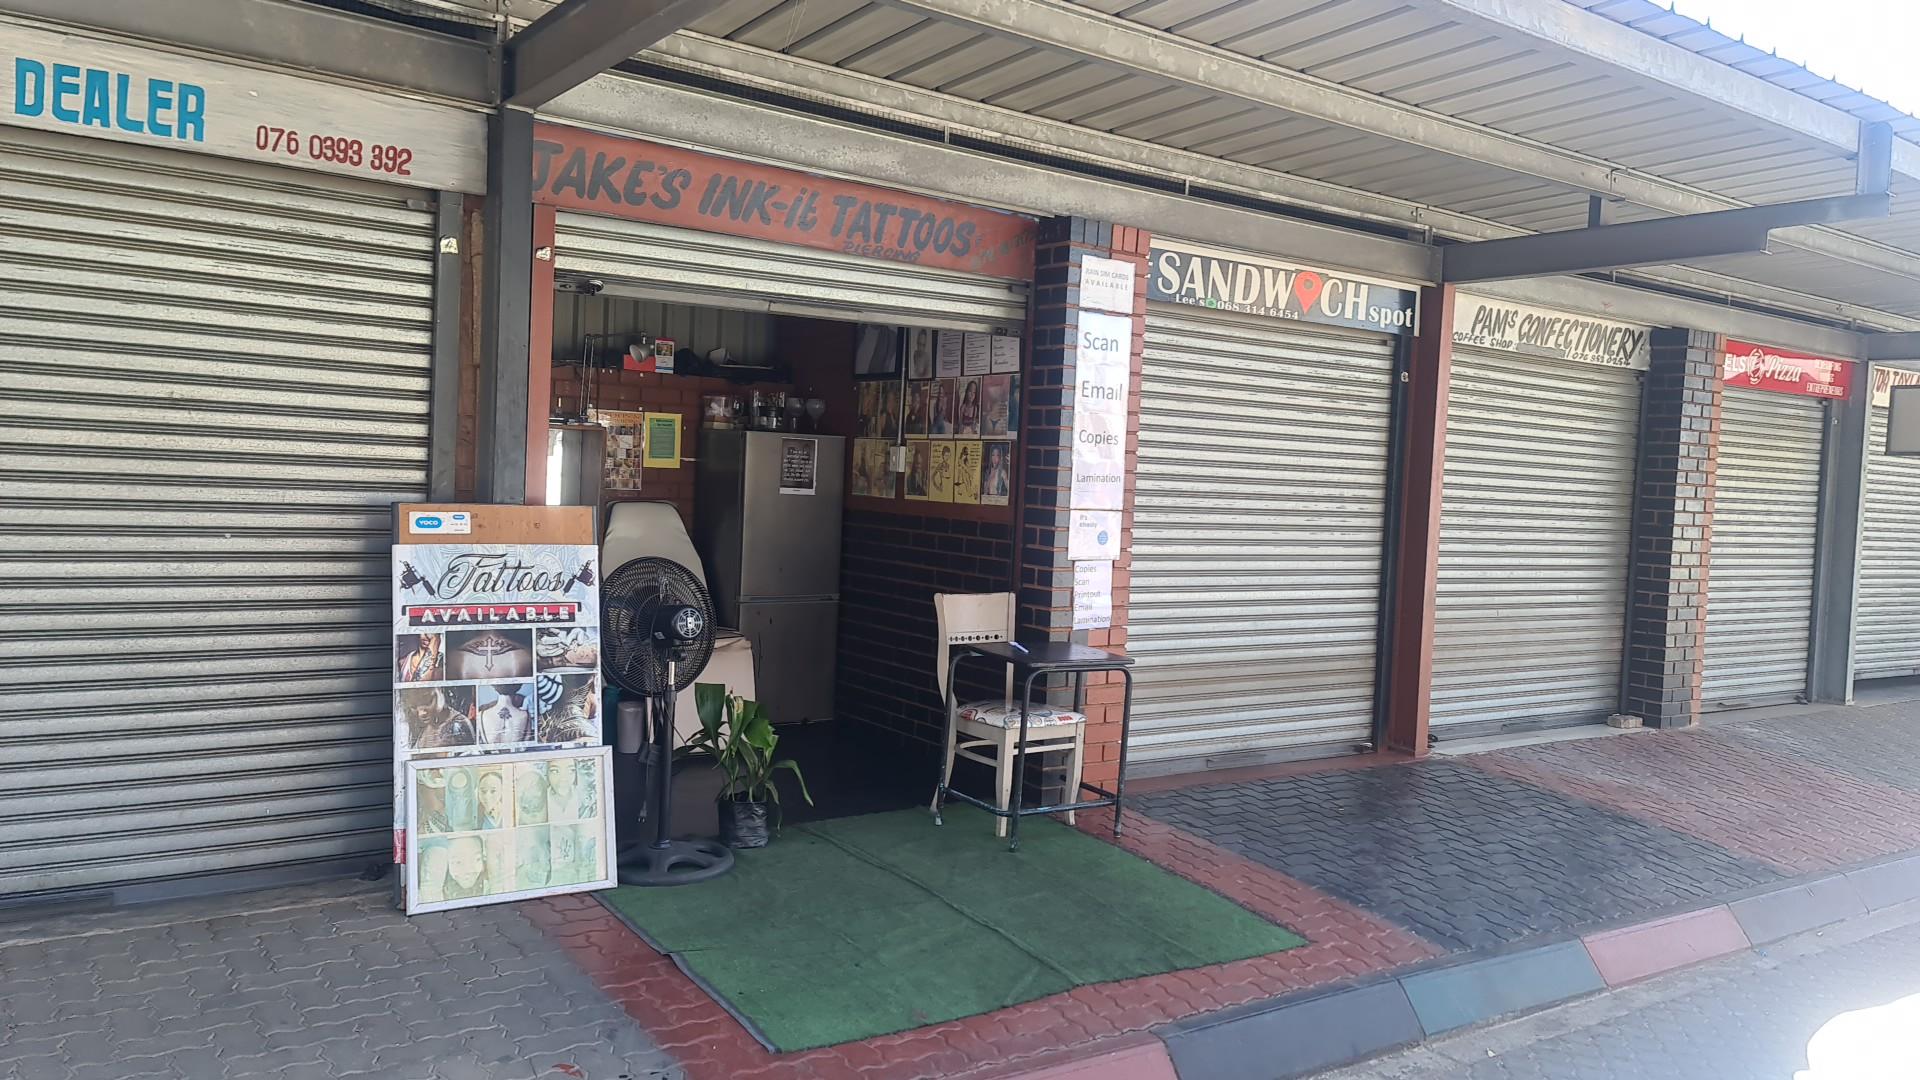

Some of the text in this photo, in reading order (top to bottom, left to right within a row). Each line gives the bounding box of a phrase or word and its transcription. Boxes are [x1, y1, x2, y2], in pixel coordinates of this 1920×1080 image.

[14, 56, 206, 143] DEALER
[255, 125, 413, 176] 076 0393 392
[532, 139, 692, 210] JAKE'S
[829, 194, 977, 257] TATTOOS
[1085, 278, 1129, 291] AVAILABLE
[1156, 251, 1413, 328] SANDWCH spot
[1175, 293, 1299, 320] Lee's 068 314 6454
[1083, 331, 1120, 353] Scan
[1453, 331, 1486, 345] COFFEE
[1470, 304, 1645, 361] PAM'S CONFECTIONERY
[1765, 354, 1801, 383] Pizza
[1081, 379, 1123, 402] Email
[1078, 429, 1120, 448] Copies
[1076, 471, 1121, 484] Lamination
[436, 552, 565, 600] Tattoos
[1074, 564, 1097, 574] Copies
[1074, 578, 1090, 586] Scan
[420, 606, 570, 624] AVAILABLE
